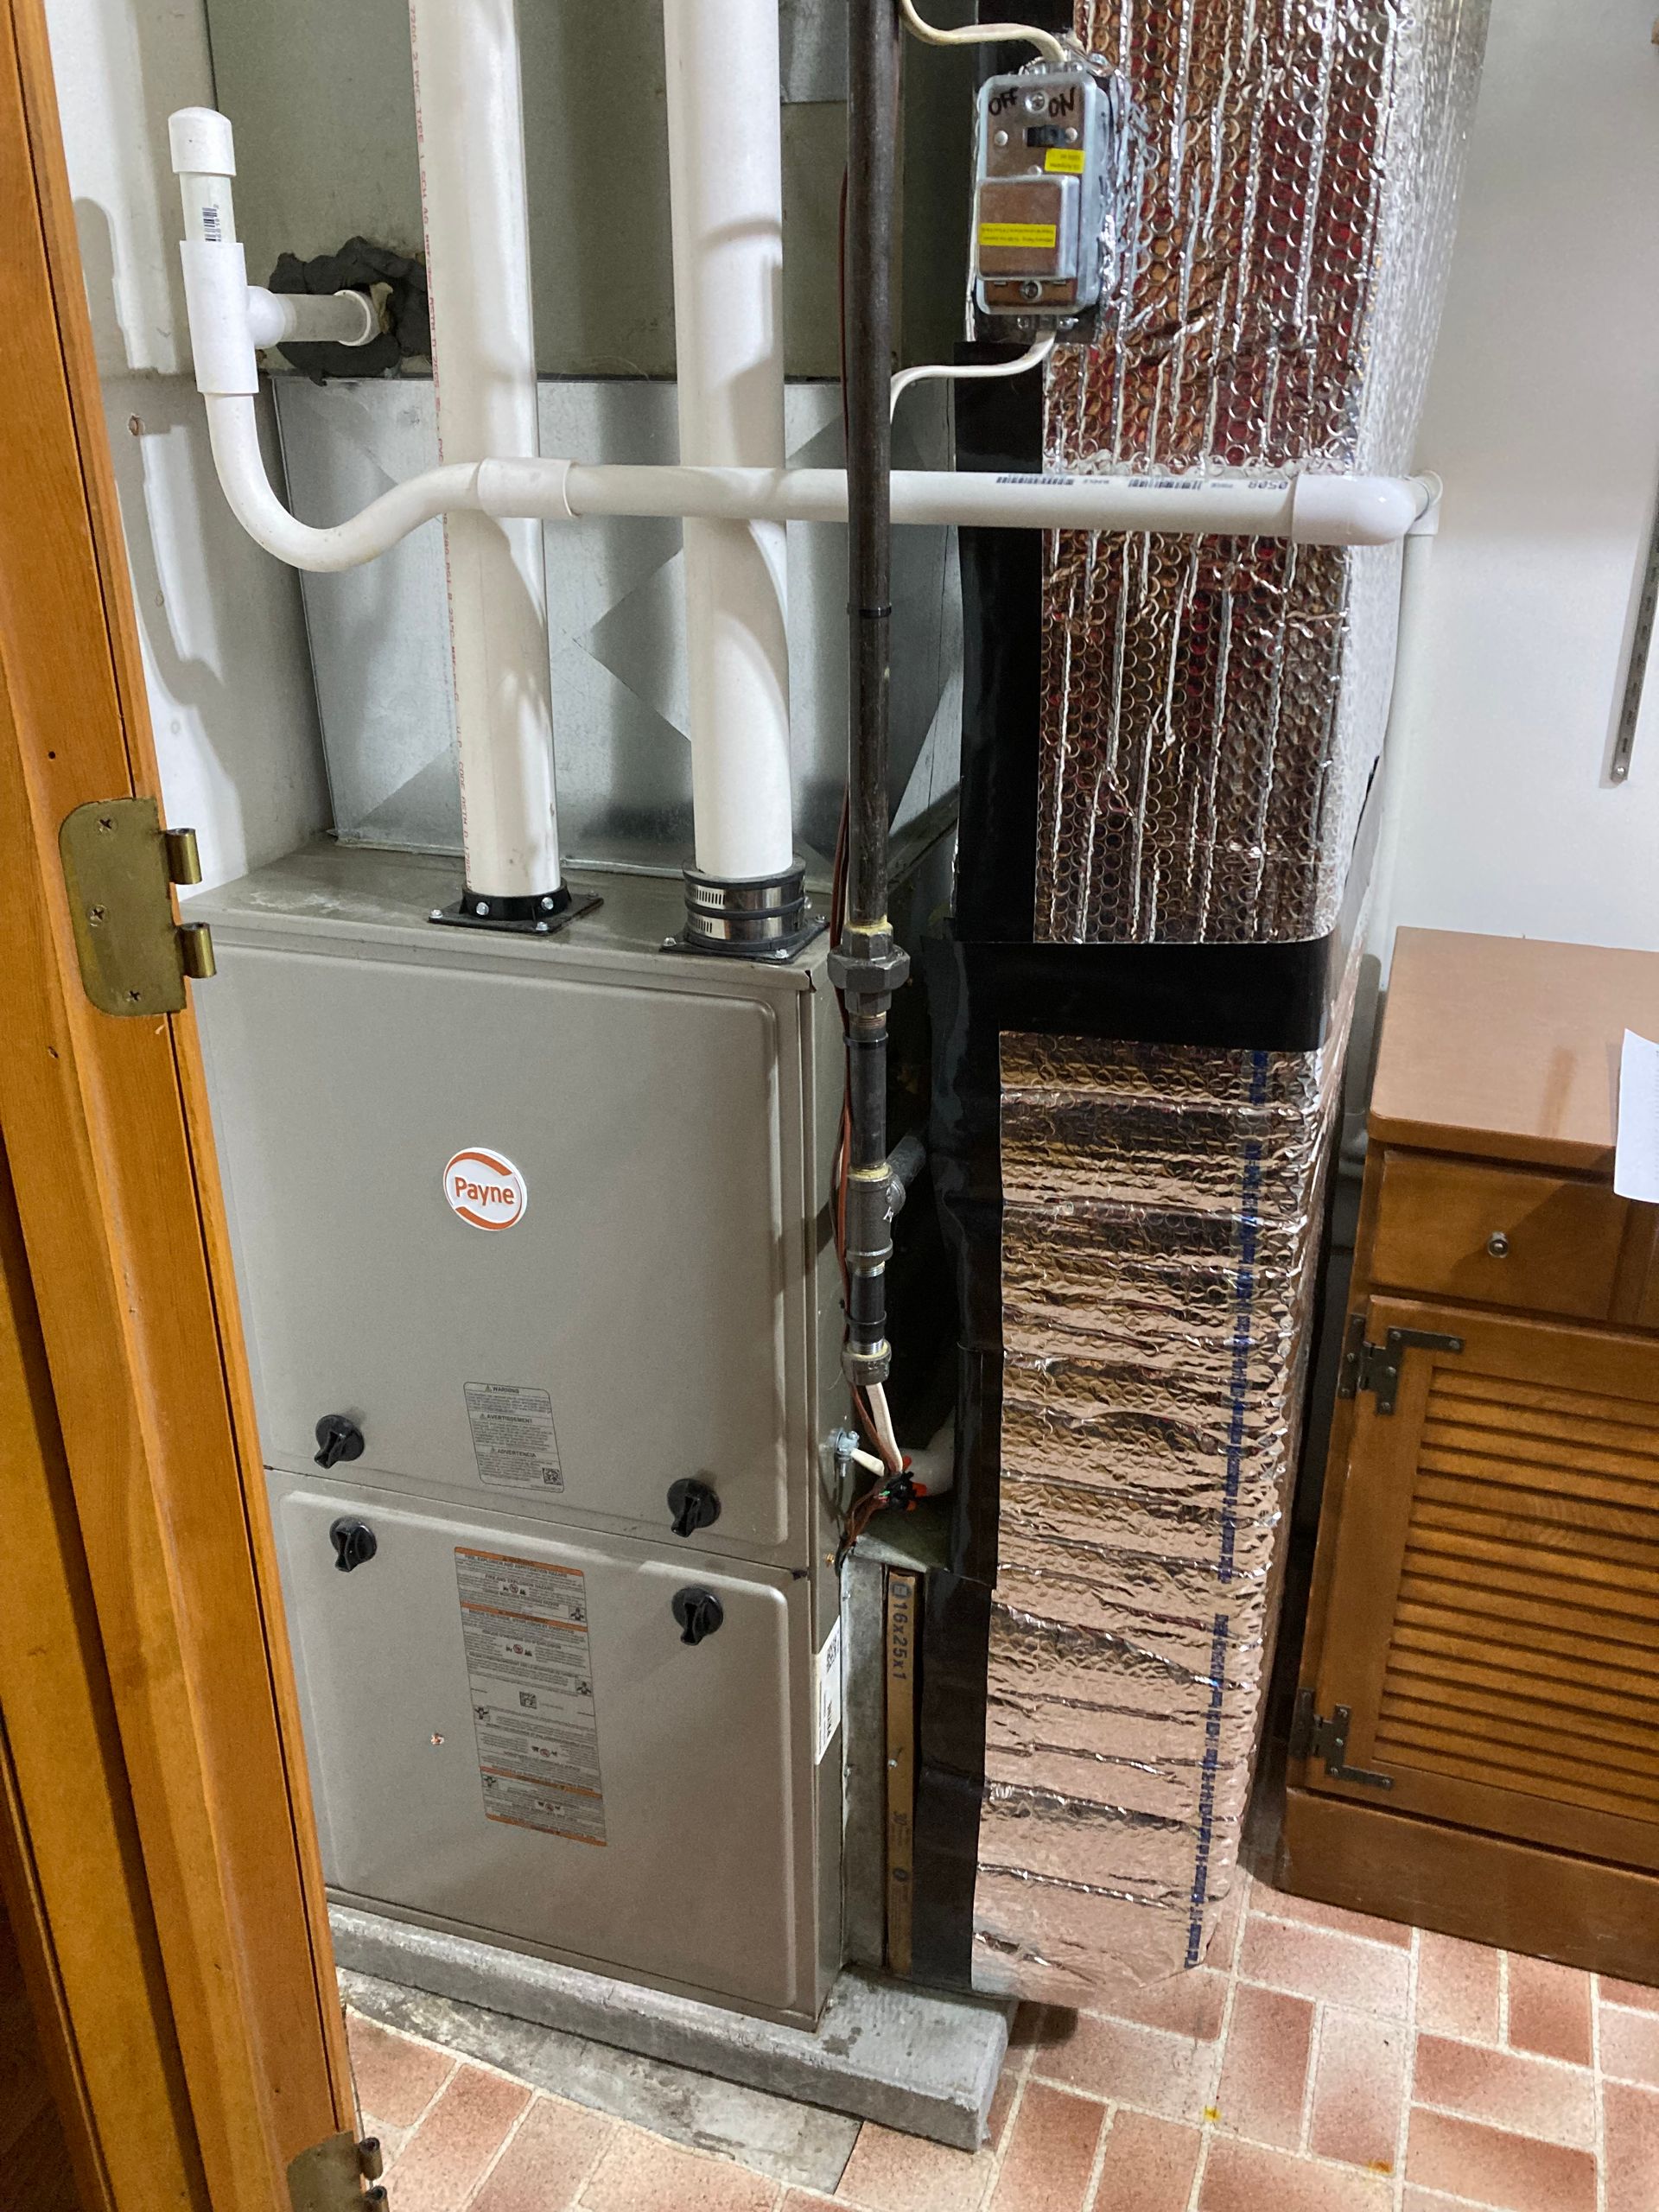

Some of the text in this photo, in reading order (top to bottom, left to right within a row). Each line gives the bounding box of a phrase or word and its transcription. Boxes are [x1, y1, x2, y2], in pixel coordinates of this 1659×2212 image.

[1048, 86, 1076, 118] ON
[454, 1176, 515, 1206] Payne
[893, 1603, 908, 1679] 16x25x1
